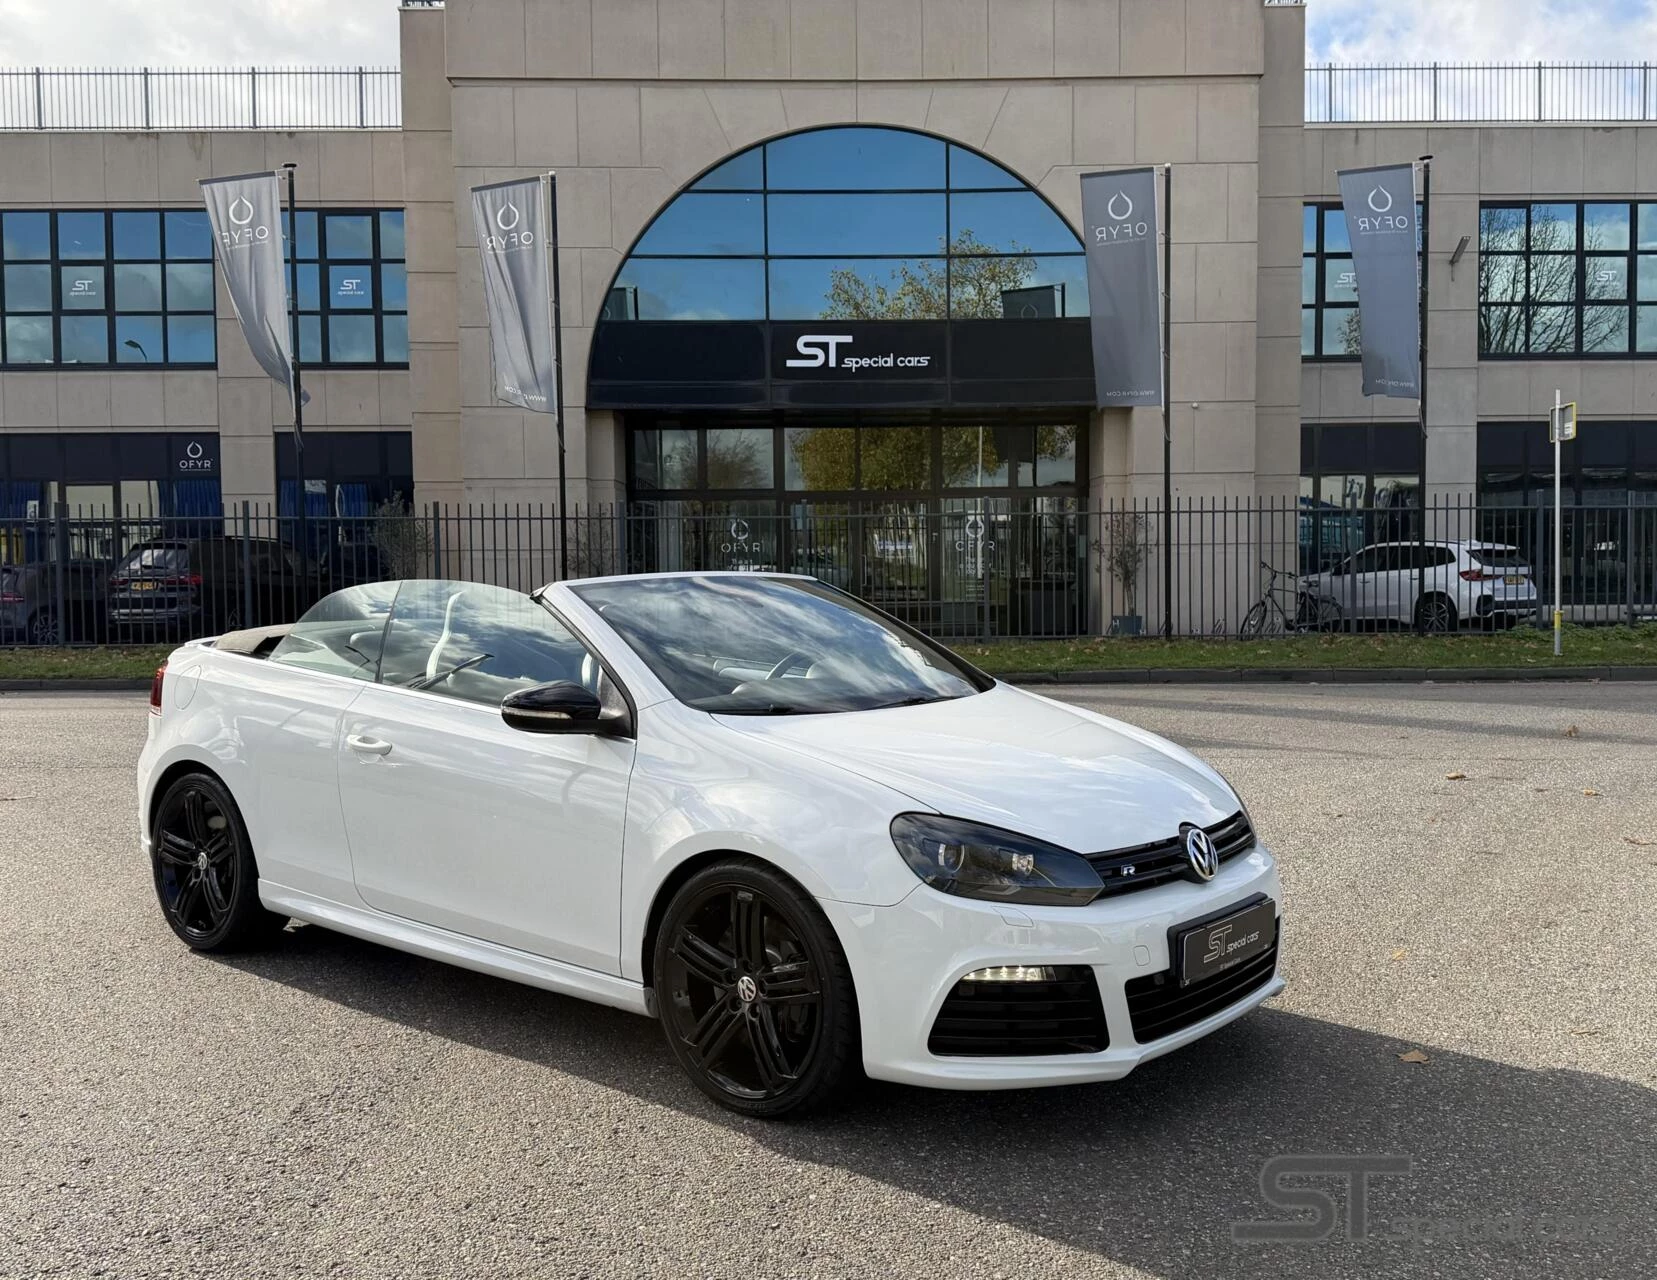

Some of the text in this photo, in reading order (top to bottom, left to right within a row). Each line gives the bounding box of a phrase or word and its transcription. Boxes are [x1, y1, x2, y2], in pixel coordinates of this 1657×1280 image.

[72, 280, 93, 291] ST
[340, 279, 361, 290] ST
[786, 335, 931, 373] ST special cars
[179, 460, 212, 469] OFYR
[1120, 863, 1136, 877] R
[1203, 924, 1233, 964] ST
